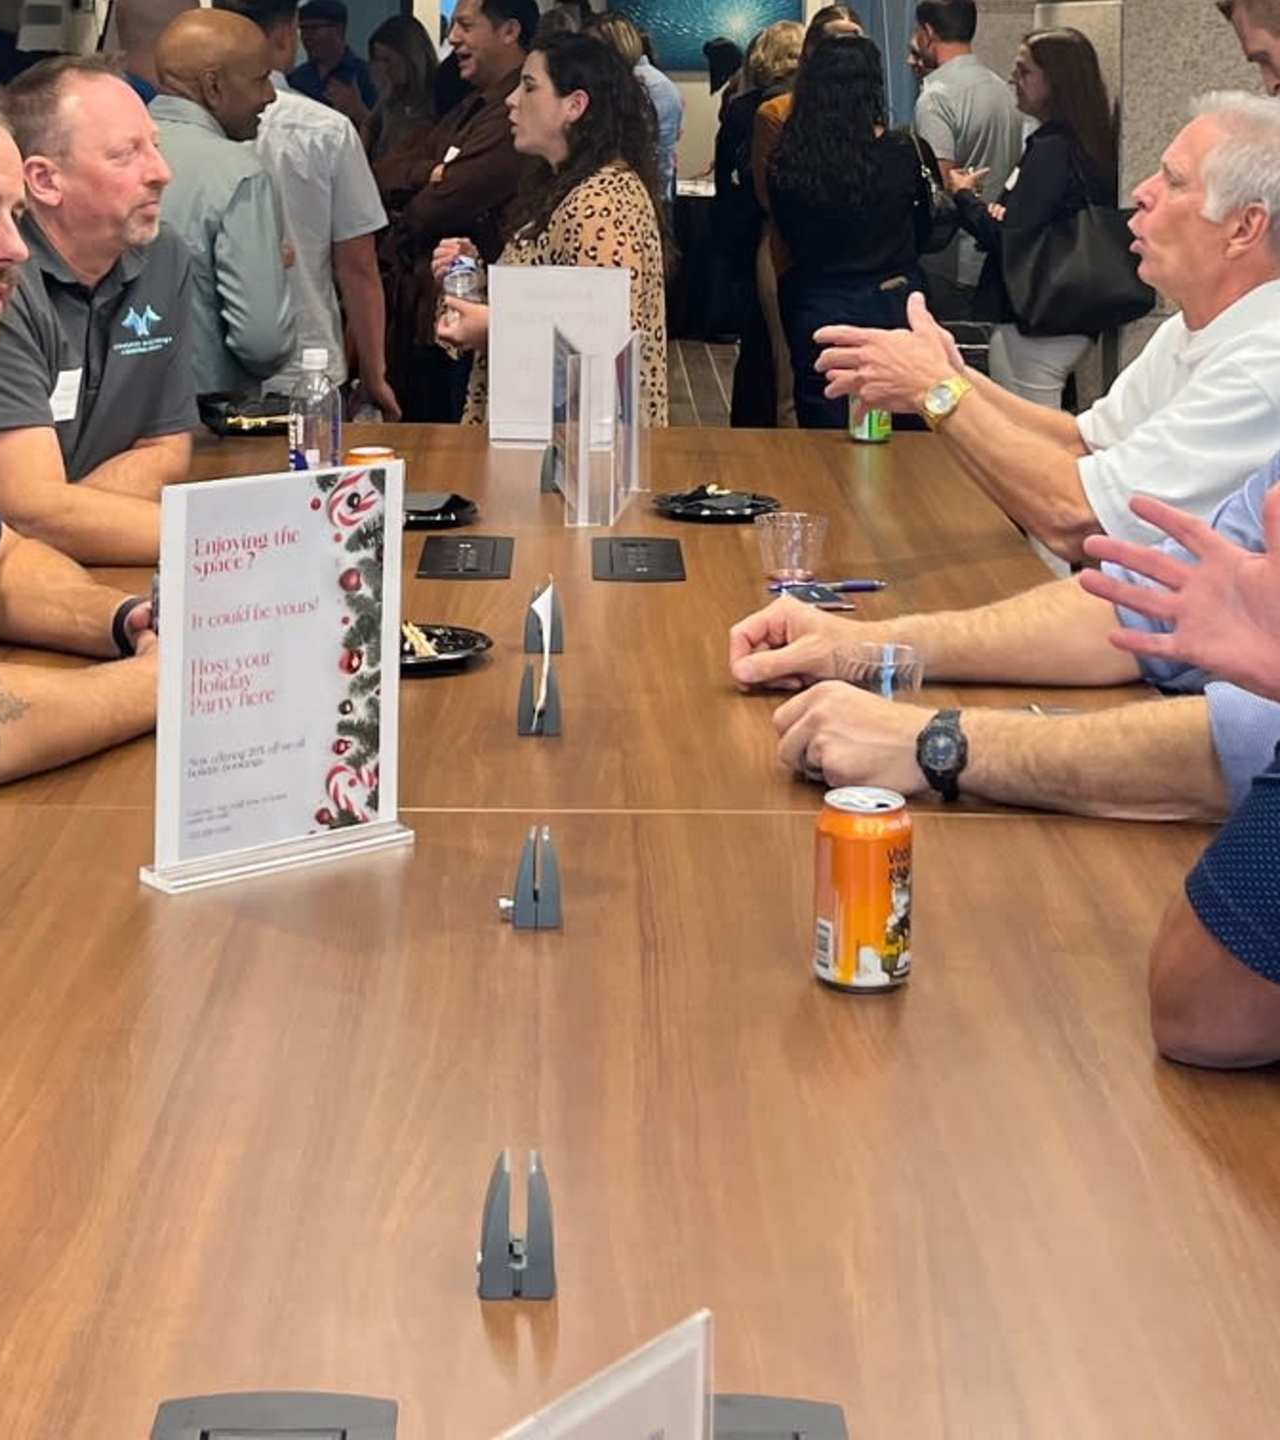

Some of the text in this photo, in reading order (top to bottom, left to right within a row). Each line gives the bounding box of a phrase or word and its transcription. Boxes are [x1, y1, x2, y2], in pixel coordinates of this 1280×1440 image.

[194, 524, 300, 560] Enjoying the
[193, 550, 256, 582] space?
[208, 603, 250, 628] could
[252, 603, 272, 622] be
[191, 653, 271, 676] Host your
[191, 672, 251, 696] Holiday
[189, 689, 276, 717] Party here
